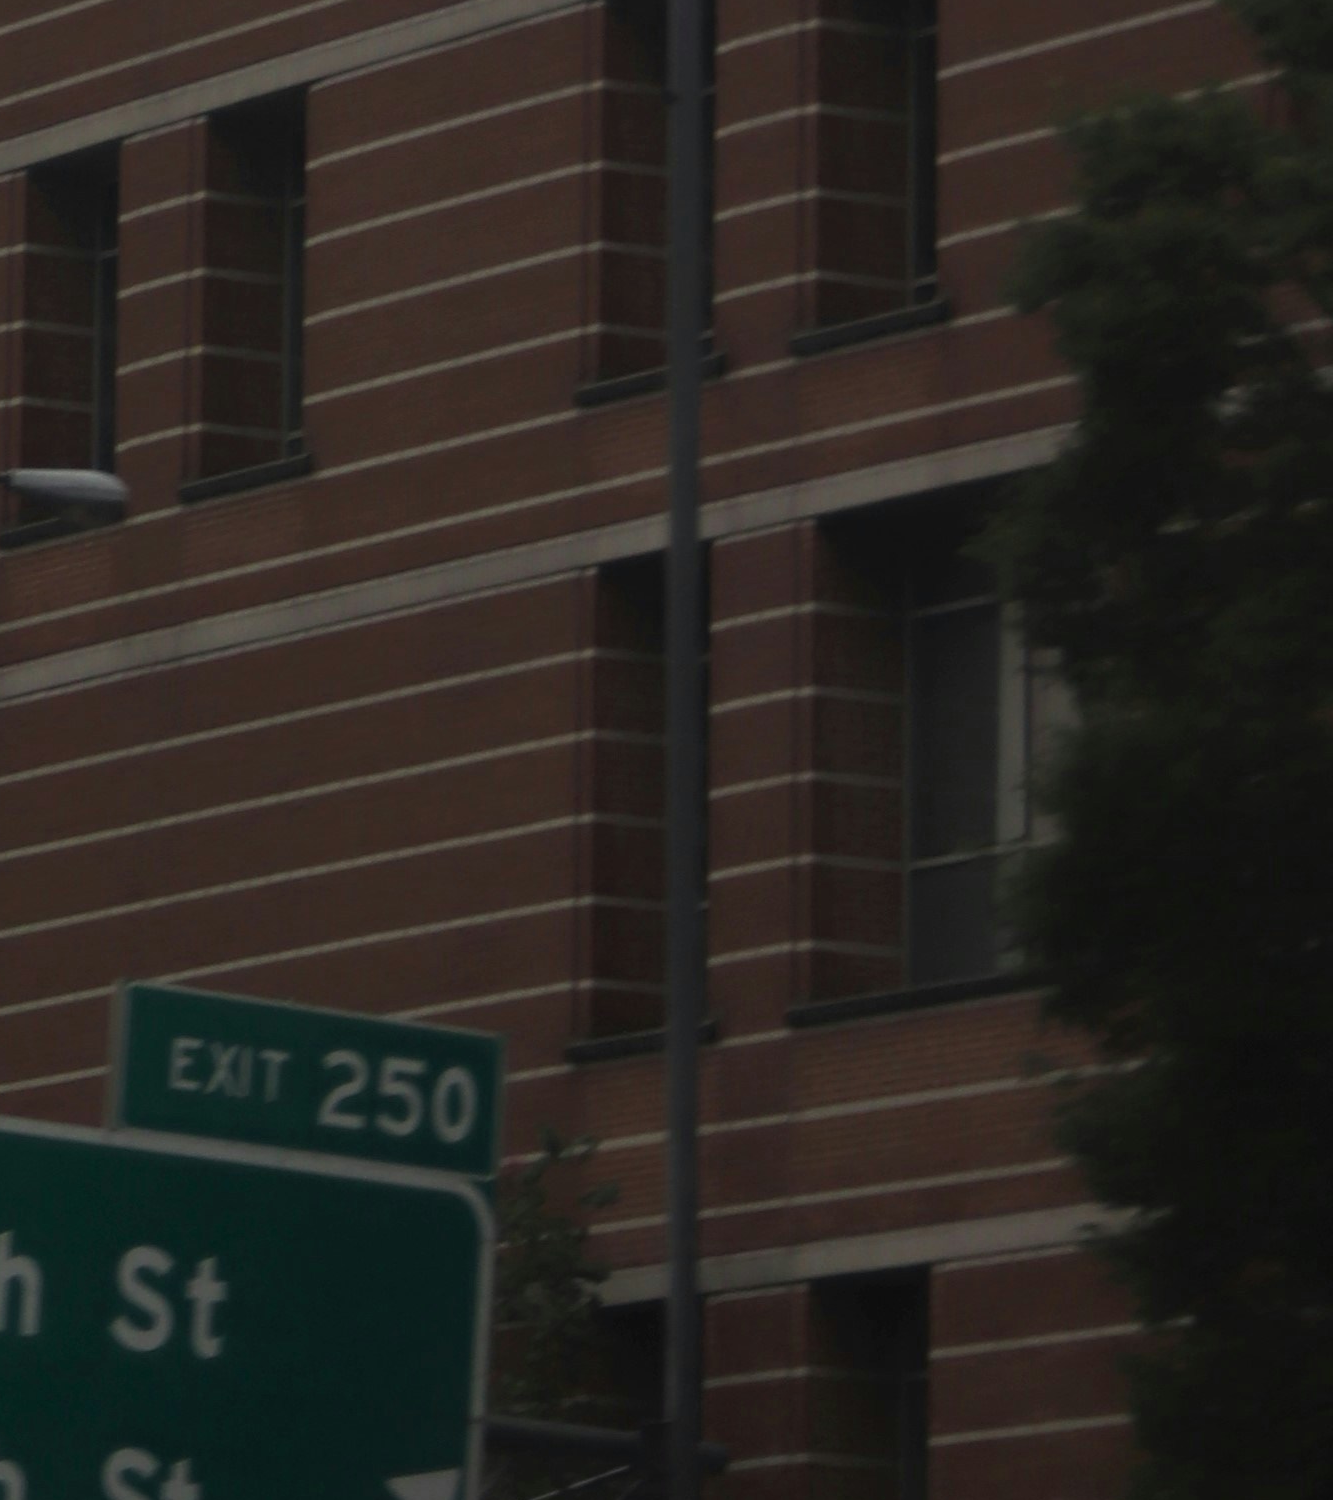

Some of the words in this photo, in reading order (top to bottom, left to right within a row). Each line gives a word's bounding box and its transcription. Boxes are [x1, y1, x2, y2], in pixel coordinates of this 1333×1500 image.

[167, 1036, 291, 1106] EXIT
[316, 1049, 479, 1146] 250
[109, 1244, 229, 1360] St
